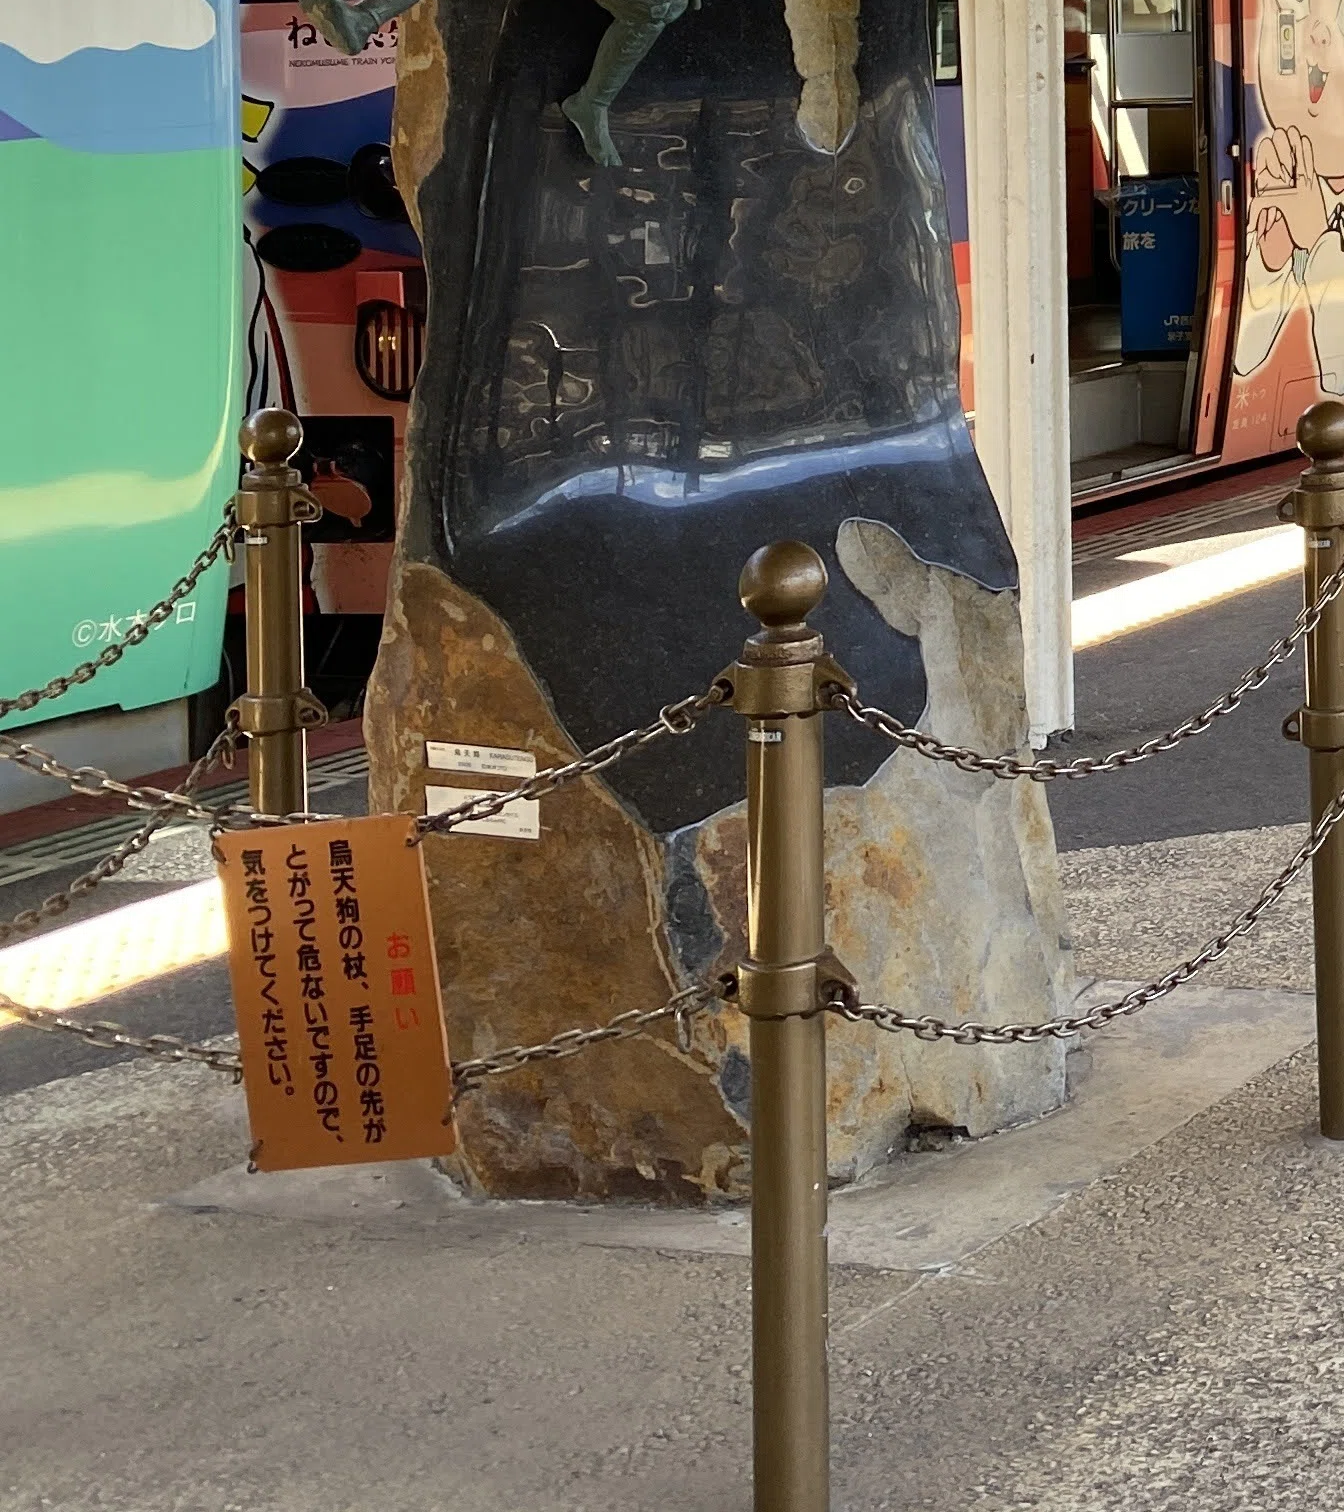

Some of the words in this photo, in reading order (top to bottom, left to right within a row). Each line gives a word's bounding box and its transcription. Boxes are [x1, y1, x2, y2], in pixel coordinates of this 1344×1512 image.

[1122, 231, 1156, 250] 旅を
[241, 849, 295, 1096] 気をつけてください。
[285, 843, 345, 1143] とがって危ないですので、
[386, 931, 420, 1030] お願い
